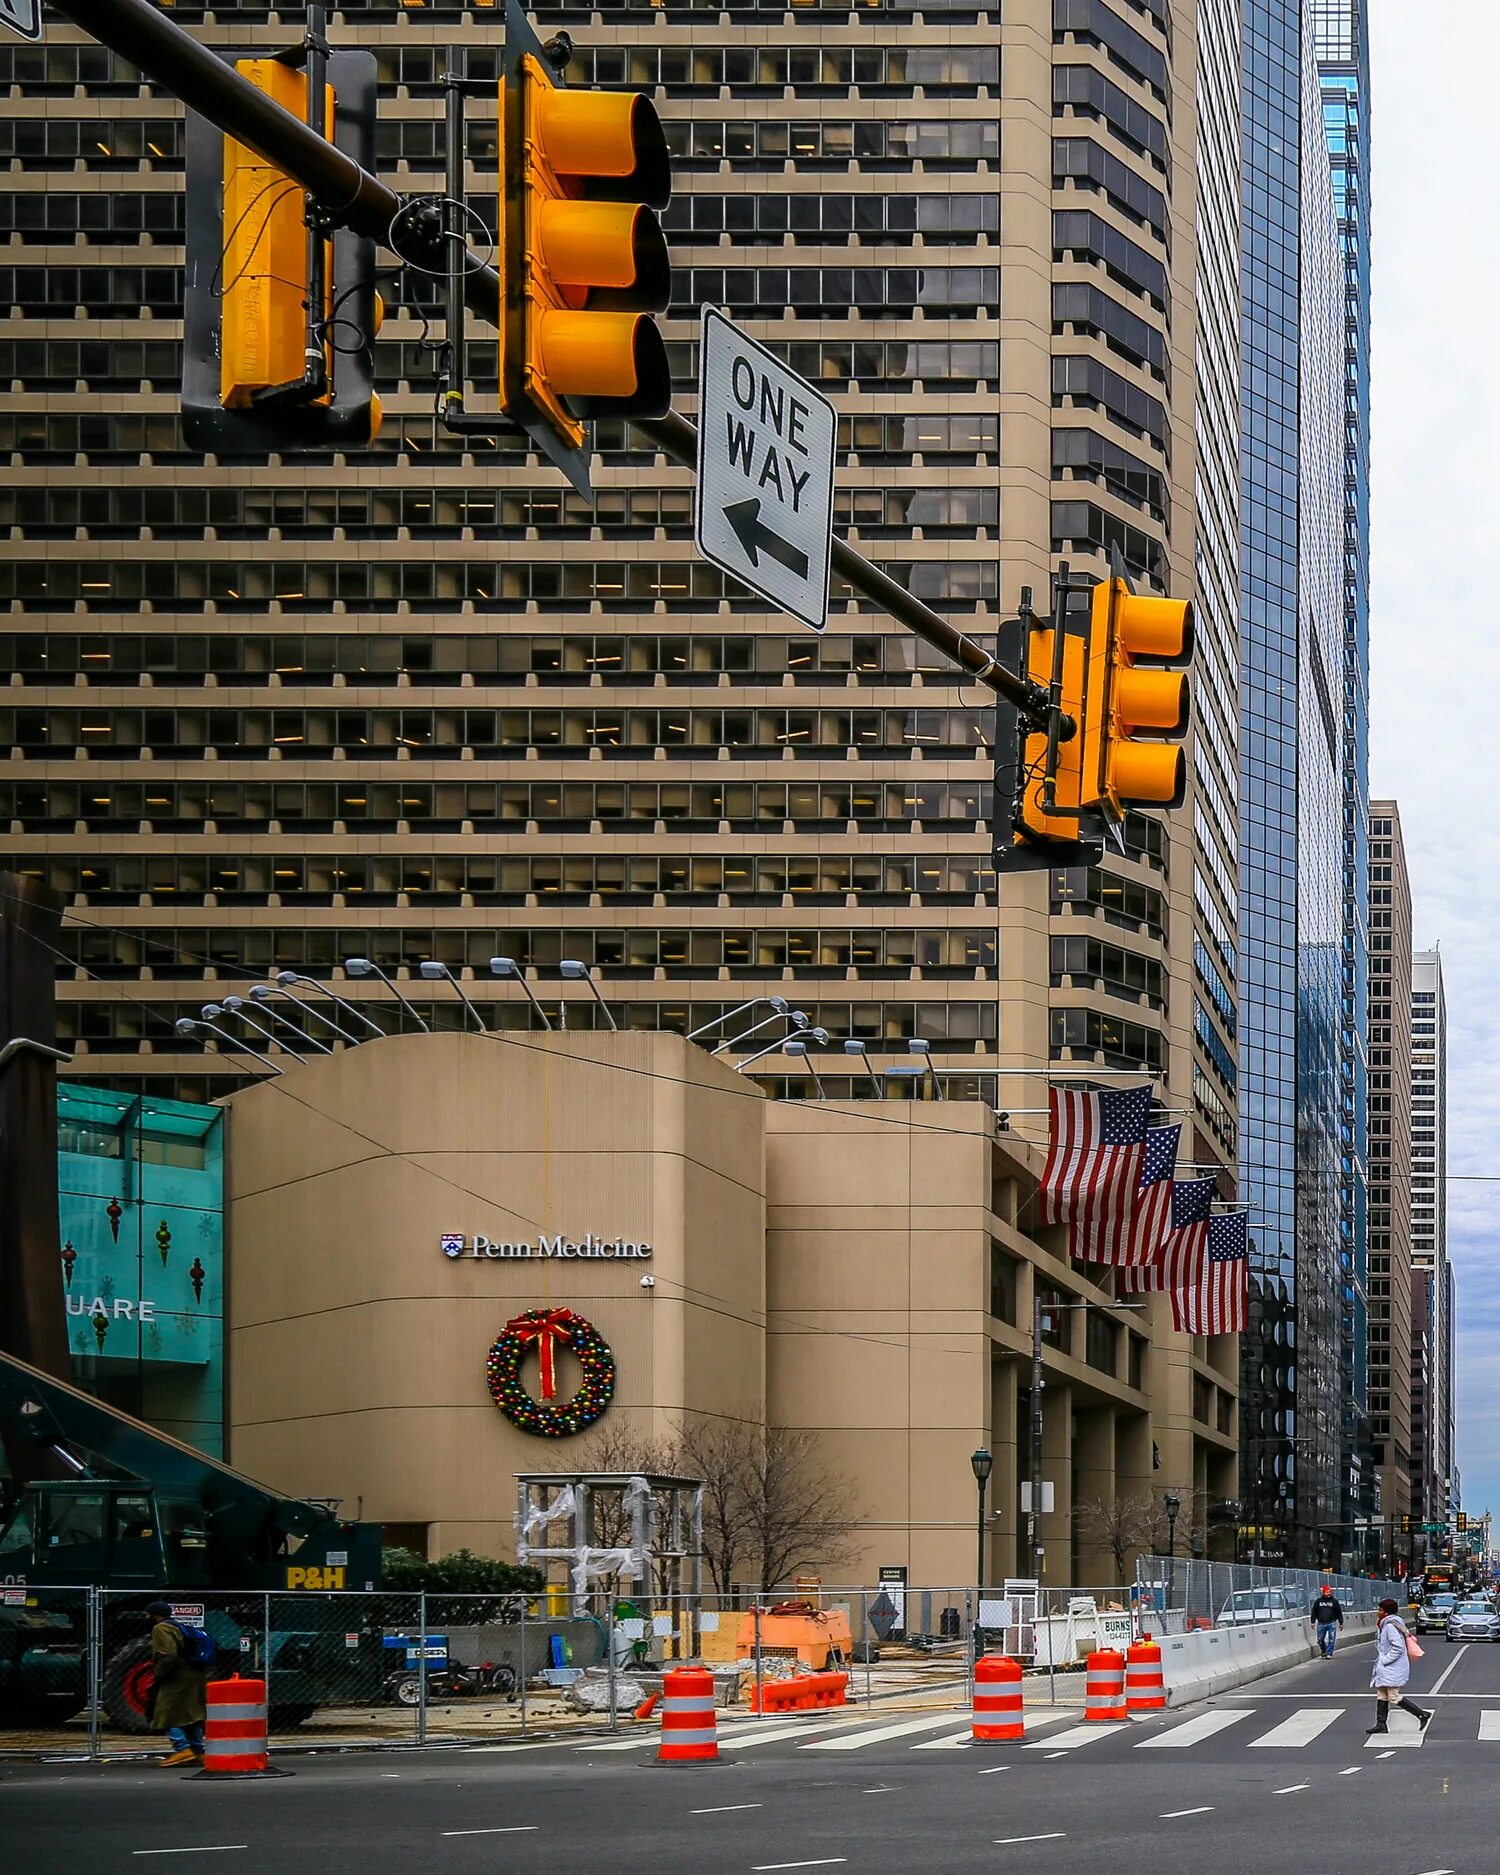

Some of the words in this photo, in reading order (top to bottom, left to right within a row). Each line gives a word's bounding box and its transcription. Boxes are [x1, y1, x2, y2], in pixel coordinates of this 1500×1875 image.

[732, 356, 809, 456] ONE
[727, 411, 810, 513] WAY
[473, 1236, 531, 1257] Penn
[538, 1234, 652, 1257] Medicine
[287, 1567, 344, 1589] P&H
[1105, 1620, 1130, 1632] BURNS
